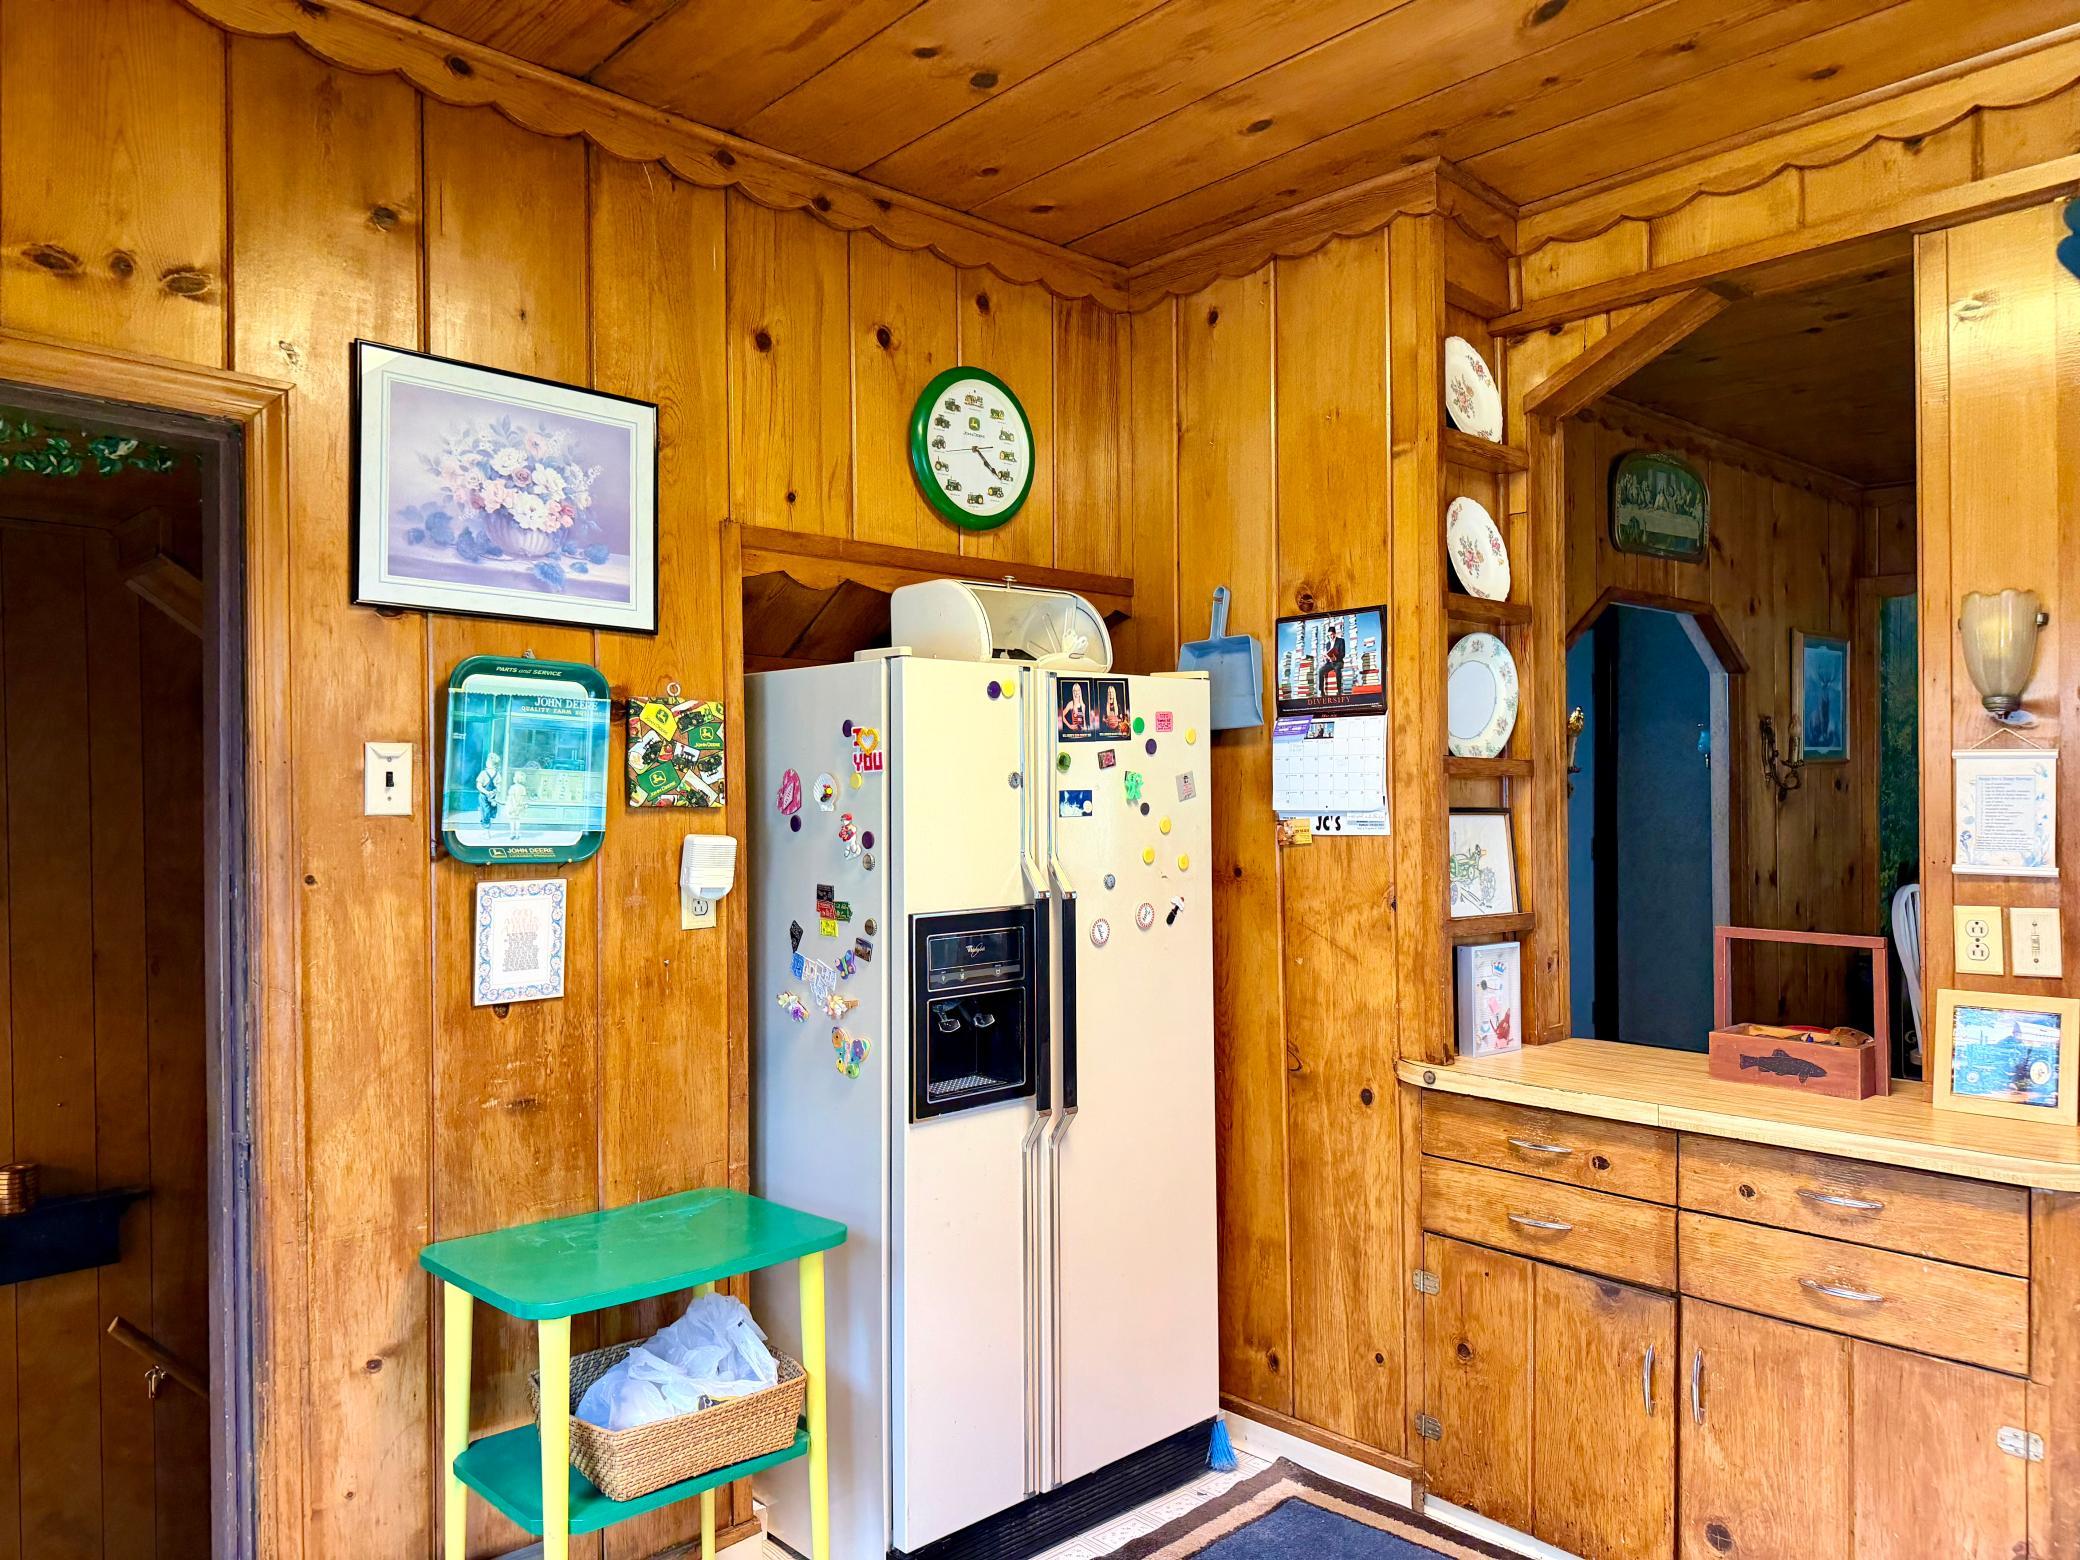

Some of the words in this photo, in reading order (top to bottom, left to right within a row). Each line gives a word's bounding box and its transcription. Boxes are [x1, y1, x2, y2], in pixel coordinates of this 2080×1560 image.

[532, 669, 562, 677] SERVICE
[534, 697, 562, 707] JOHN
[565, 699, 599, 710] DEERE
[1307, 696, 1351, 705] DIVERSIFY
[853, 752, 883, 771] YOU
[1315, 815, 1341, 831] JC'S
